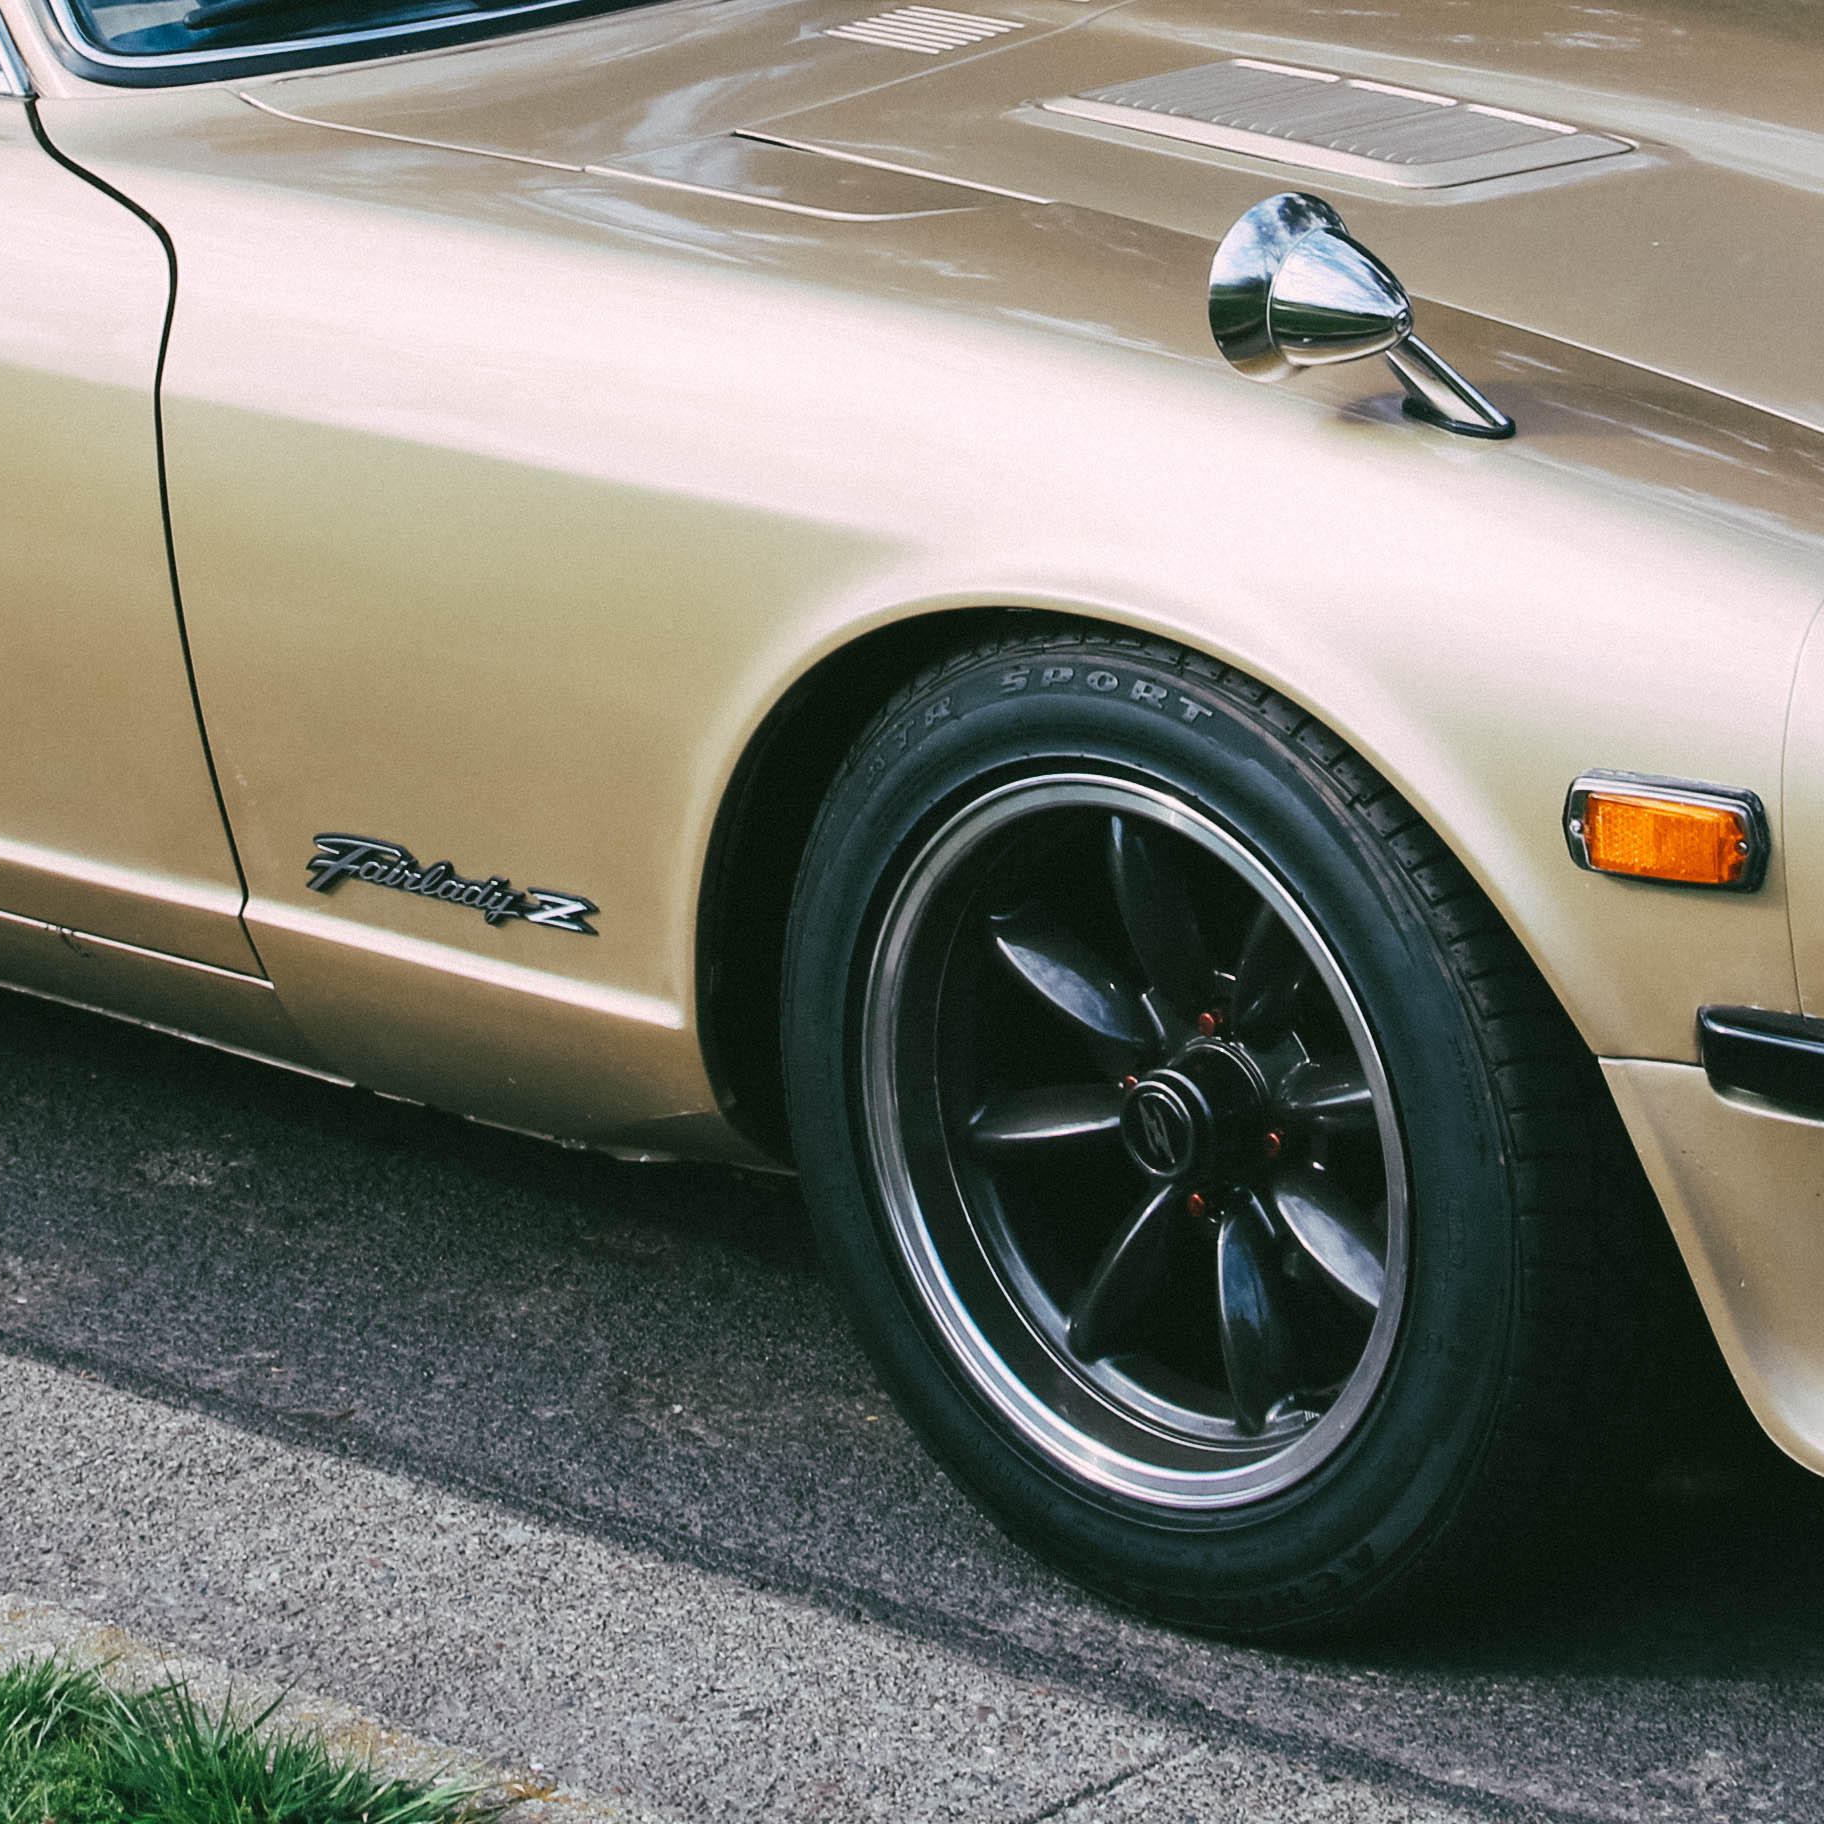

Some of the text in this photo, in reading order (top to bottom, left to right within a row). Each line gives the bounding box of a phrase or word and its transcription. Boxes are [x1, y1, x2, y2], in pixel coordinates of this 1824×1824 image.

[1000, 666, 1213, 724] SPORT
[305, 832, 600, 937] Fairlady Z
